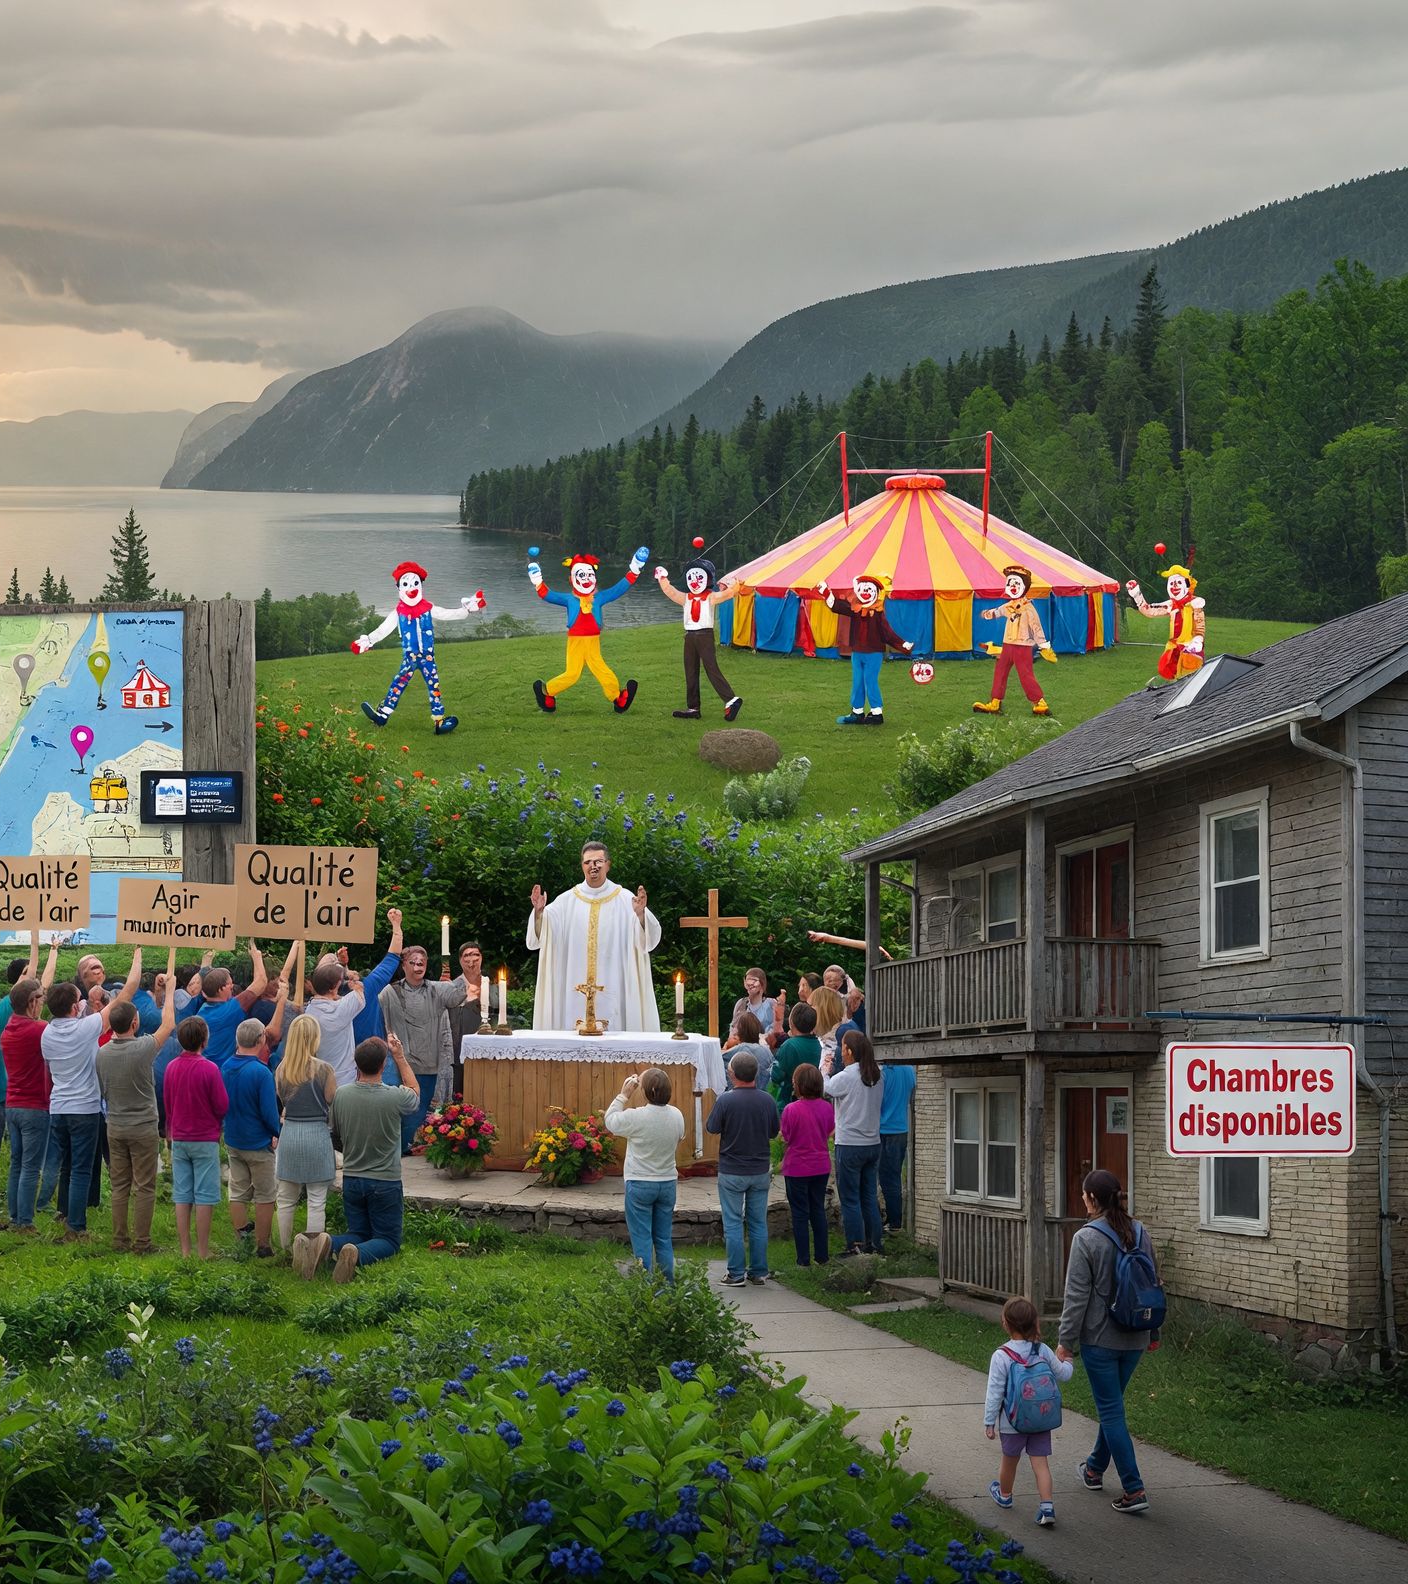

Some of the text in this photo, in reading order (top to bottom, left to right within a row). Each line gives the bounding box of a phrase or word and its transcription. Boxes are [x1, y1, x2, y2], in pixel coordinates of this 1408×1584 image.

[245, 848, 356, 887] Qualité
[39, 893, 80, 923] l'air
[152, 884, 200, 914] Agir
[253, 889, 360, 929] de l'air
[1186, 1058, 1334, 1093] Chambres
[1178, 1103, 1342, 1144] disponibles
